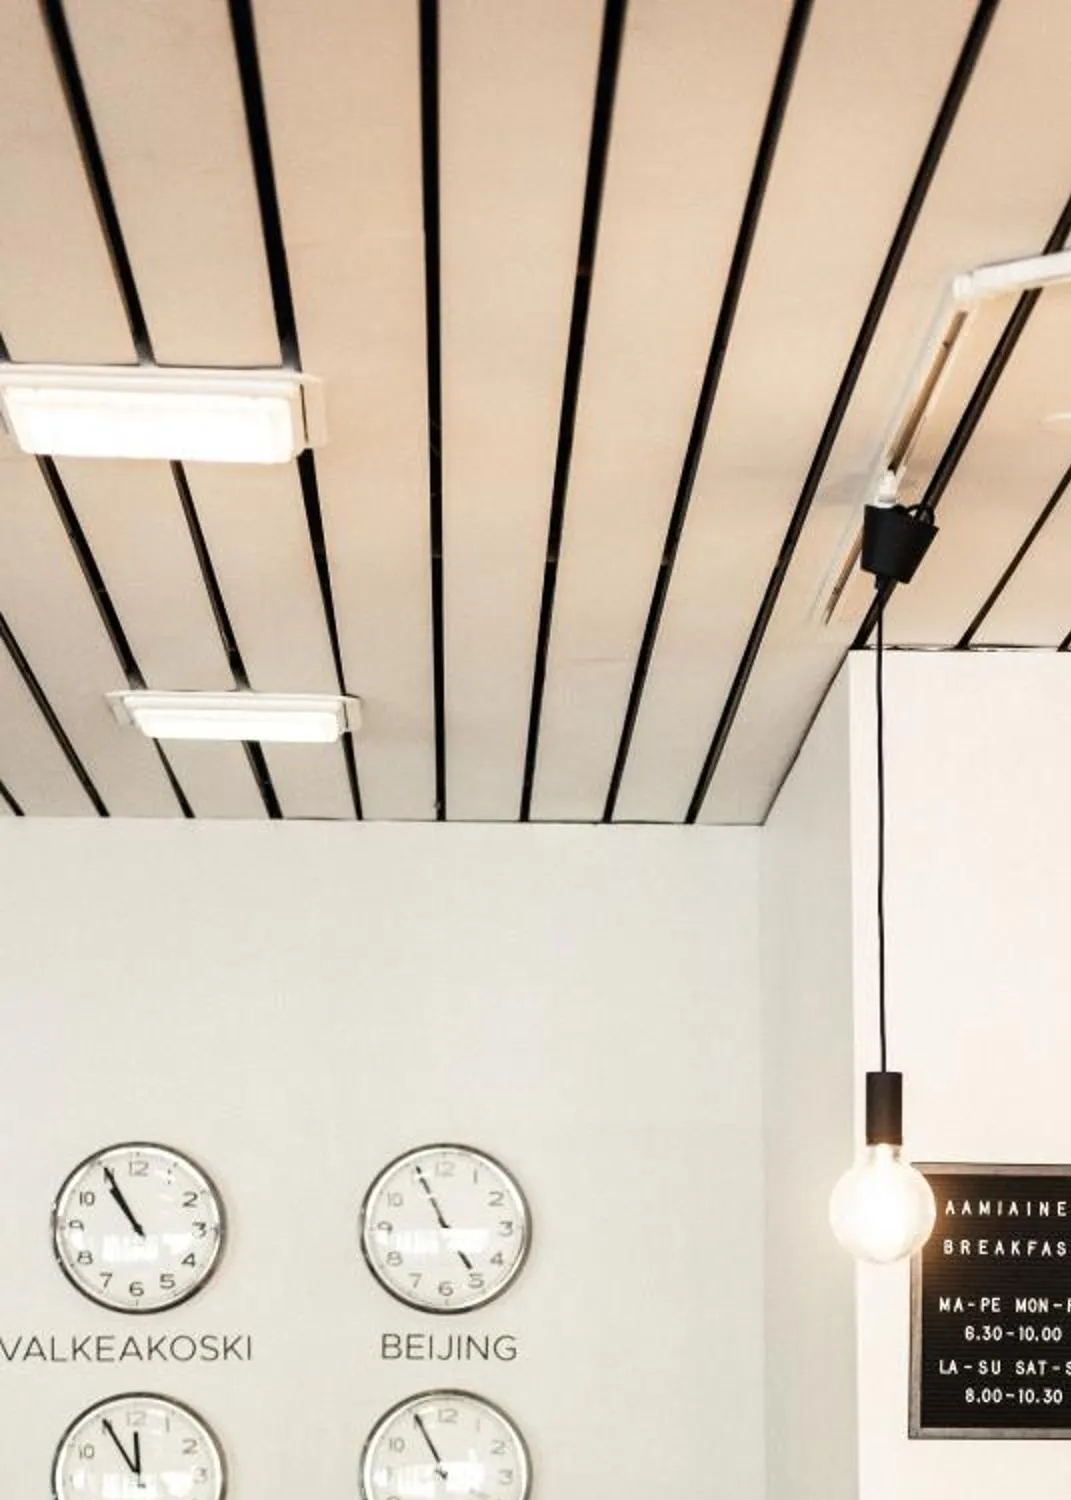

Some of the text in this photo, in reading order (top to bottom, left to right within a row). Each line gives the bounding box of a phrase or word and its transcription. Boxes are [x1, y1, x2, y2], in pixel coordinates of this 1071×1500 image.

[129, 1161, 148, 1177] 12
[79, 1191, 95, 1206] 10
[182, 1191, 198, 1207] 2
[488, 1191, 504, 1206] 2
[192, 1222, 206, 1237] 3
[499, 1221, 513, 1237] 3
[77, 1251, 93, 1264] 8
[181, 1253, 195, 1267] 4
[386, 1252, 403, 1266] 8
[490, 1252, 503, 1266] 4
[100, 1273, 112, 1288] 7
[160, 1274, 175, 1289] 5
[409, 1273, 422, 1288] 7
[468, 1274, 484, 1289] 5
[129, 1282, 144, 1296] 6
[438, 1281, 453, 1296] 6
[0, 1335, 253, 1362] VALKEAKOSKI
[381, 1333, 518, 1362] BEIJING
[438, 1409, 457, 1423] 12
[79, 1444, 94, 1459] 10
[182, 1439, 198, 1454] 2
[389, 1438, 405, 1452] 10
[491, 1440, 505, 1454] 2
[499, 1470, 513, 1485] 3
